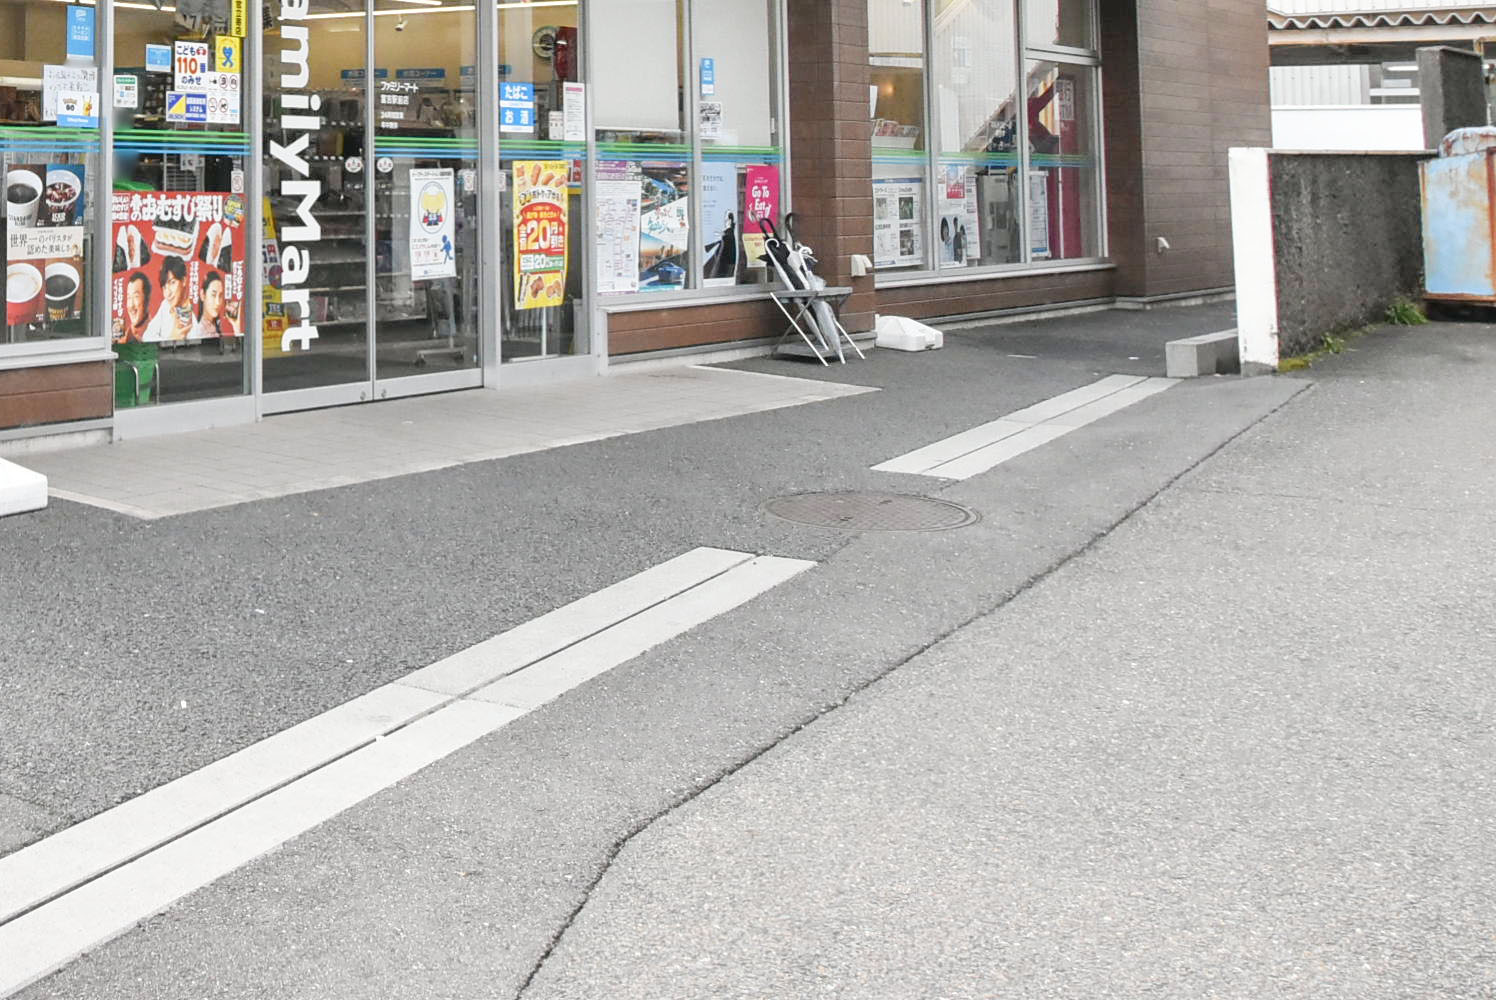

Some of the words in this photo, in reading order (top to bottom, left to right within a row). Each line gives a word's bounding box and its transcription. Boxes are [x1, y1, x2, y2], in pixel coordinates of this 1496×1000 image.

[176, 44, 196, 56] こども
[181, 76, 202, 86] のみせ
[380, 81, 419, 93] ファミリーマート
[505, 84, 528, 100] たばこ
[752, 186, 761, 198] Go
[762, 185, 770, 198] To
[754, 199, 766, 211] Eat
